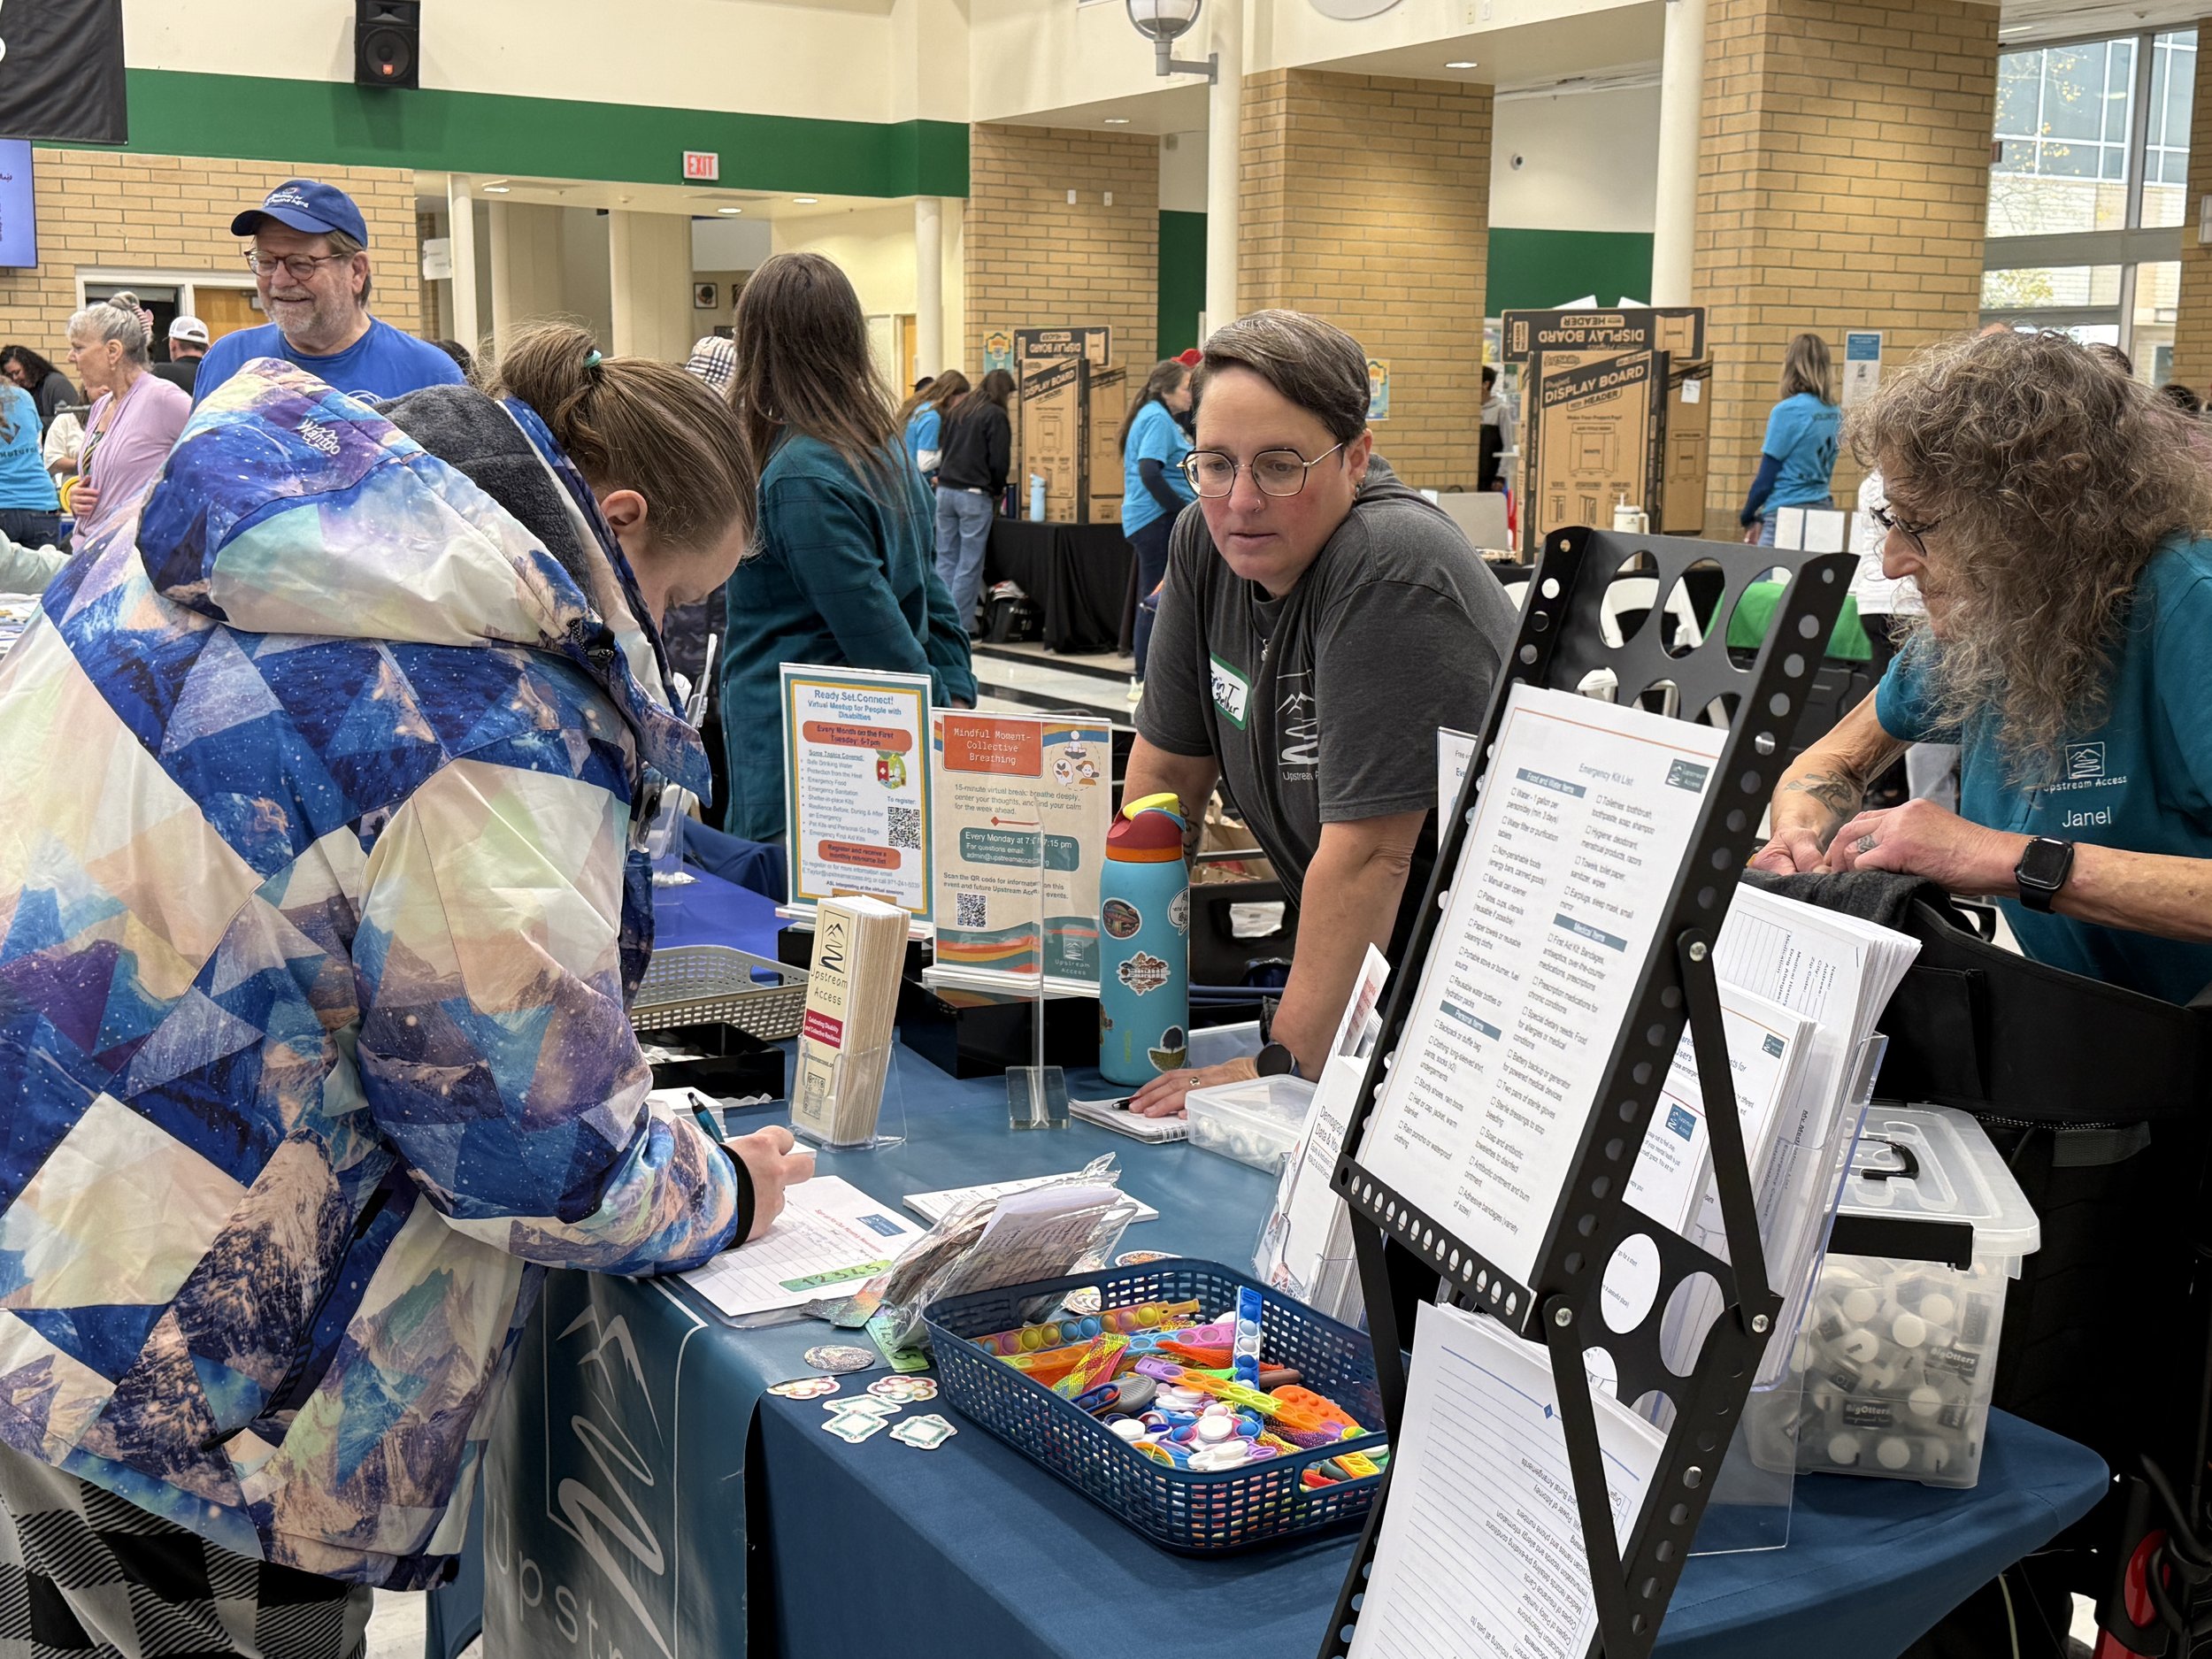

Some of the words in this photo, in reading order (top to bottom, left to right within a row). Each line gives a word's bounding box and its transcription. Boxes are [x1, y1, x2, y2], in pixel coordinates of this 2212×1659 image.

[687, 154, 715, 178] EXIT
[1564, 317, 1606, 326] HEADER
[1538, 330, 1585, 342] BOARD
[1588, 329, 1645, 342] DISPLAY
[1029, 343, 1053, 353] BOARD
[1054, 342, 1081, 353] DISPLAY
[1025, 380, 1050, 397] DISPLAY
[1051, 370, 1074, 387] BOARD
[1545, 379, 1596, 403] DISPLAY
[1599, 365, 1645, 388] BOARD
[1584, 389, 1618, 407] HEADER
[296, 419, 341, 455] Wantdo
[808, 700, 828, 709] Virtual
[830, 702, 853, 711] Meetup
[839, 711, 872, 721] Disabilities
[817, 725, 834, 733] Every
[836, 726, 856, 735] Month
[867, 728, 877, 737] the
[954, 728, 989, 739] Mindful
[995, 731, 1032, 741] Moment-
[966, 741, 1018, 752] Collective
[1455, 750, 1464, 759] Free
[818, 759, 838, 769] Drinking
[969, 752, 1017, 765] Breathing
[808, 776, 833, 787] Emergency
[1578, 763, 1610, 782] Emergency
[1611, 772, 1621, 783] Kit
[1621, 774, 1634, 786] List
[2095, 775, 2128, 788] Access
[808, 786, 833, 795] Emergency
[955, 784, 986, 794] 15-minute
[1030, 790, 1055, 799] breathe
[1056, 792, 1080, 802] deeply,
[991, 796, 1021, 806] thoughts,
[995, 806, 1017, 815] ahead.
[2062, 806, 2112, 828] Janel
[1507, 818, 1520, 829] Water
[1520, 821, 1531, 832] filter
[1534, 826, 1559, 842] purification
[965, 832, 985, 842] Every
[987, 833, 1016, 845] Monday
[1060, 841, 1072, 851] pm
[979, 844, 1006, 853] questions
[993, 886, 1021, 895] Upstream
[1487, 875, 1503, 887] Manual
[1503, 882, 1512, 891] can
[1511, 885, 1527, 897] opener
[1572, 922, 1593, 937] Medical
[1055, 958, 1091, 968] Upstream
[1776, 934, 1791, 974] Medication
[1785, 949, 1794, 966] Drug
[1062, 967, 1087, 976] Access
[1790, 951, 1801, 979] Medical
[810, 967, 849, 990] Upstream
[1802, 971, 1811, 993] Code:
[1817, 963, 1829, 997] Address:
[1826, 965, 1836, 991] Name:
[814, 987, 841, 1006] Access
[1537, 979, 1564, 998] Prescription
[1563, 992, 1591, 1010] medications
[1781, 981, 1793, 1007] History
[1800, 1110, 1809, 1123] My
[1316, 1123, 1326, 1141] Data
[1326, 1133, 1331, 1145] &
[1930, 1347, 1976, 1364] BigOtters
[1846, 1403, 1891, 1415] BigOtters
[1520, 1455, 1554, 1490] Arrangements
[1532, 1484, 1553, 1506] Attorney
[1553, 1483, 1567, 1500] Burial
[1566, 1494, 1576, 1507] and
[1551, 1501, 1557, 1510] of
[1557, 1505, 1572, 1523] Power
[1485, 1518, 1508, 1544] conditions
[1495, 1509, 1521, 1536] information
[1520, 1530, 1536, 1549] allergy
[1507, 1538, 1532, 1566] pre-existing
[1535, 1545, 1544, 1556] and
[1544, 1552, 1561, 1571] records
[1532, 1560, 1550, 1582] detailing
[1522, 1572, 1537, 1590] Cards
[1549, 1578, 1565, 1597] records
[1559, 1568, 1587, 1598] Immunization
[1536, 1586, 1556, 1609] Insurance
[1564, 1594, 1582, 1614] Medical
[1555, 1605, 1562, 1615] of
[1561, 1609, 1577, 1629] Copies
